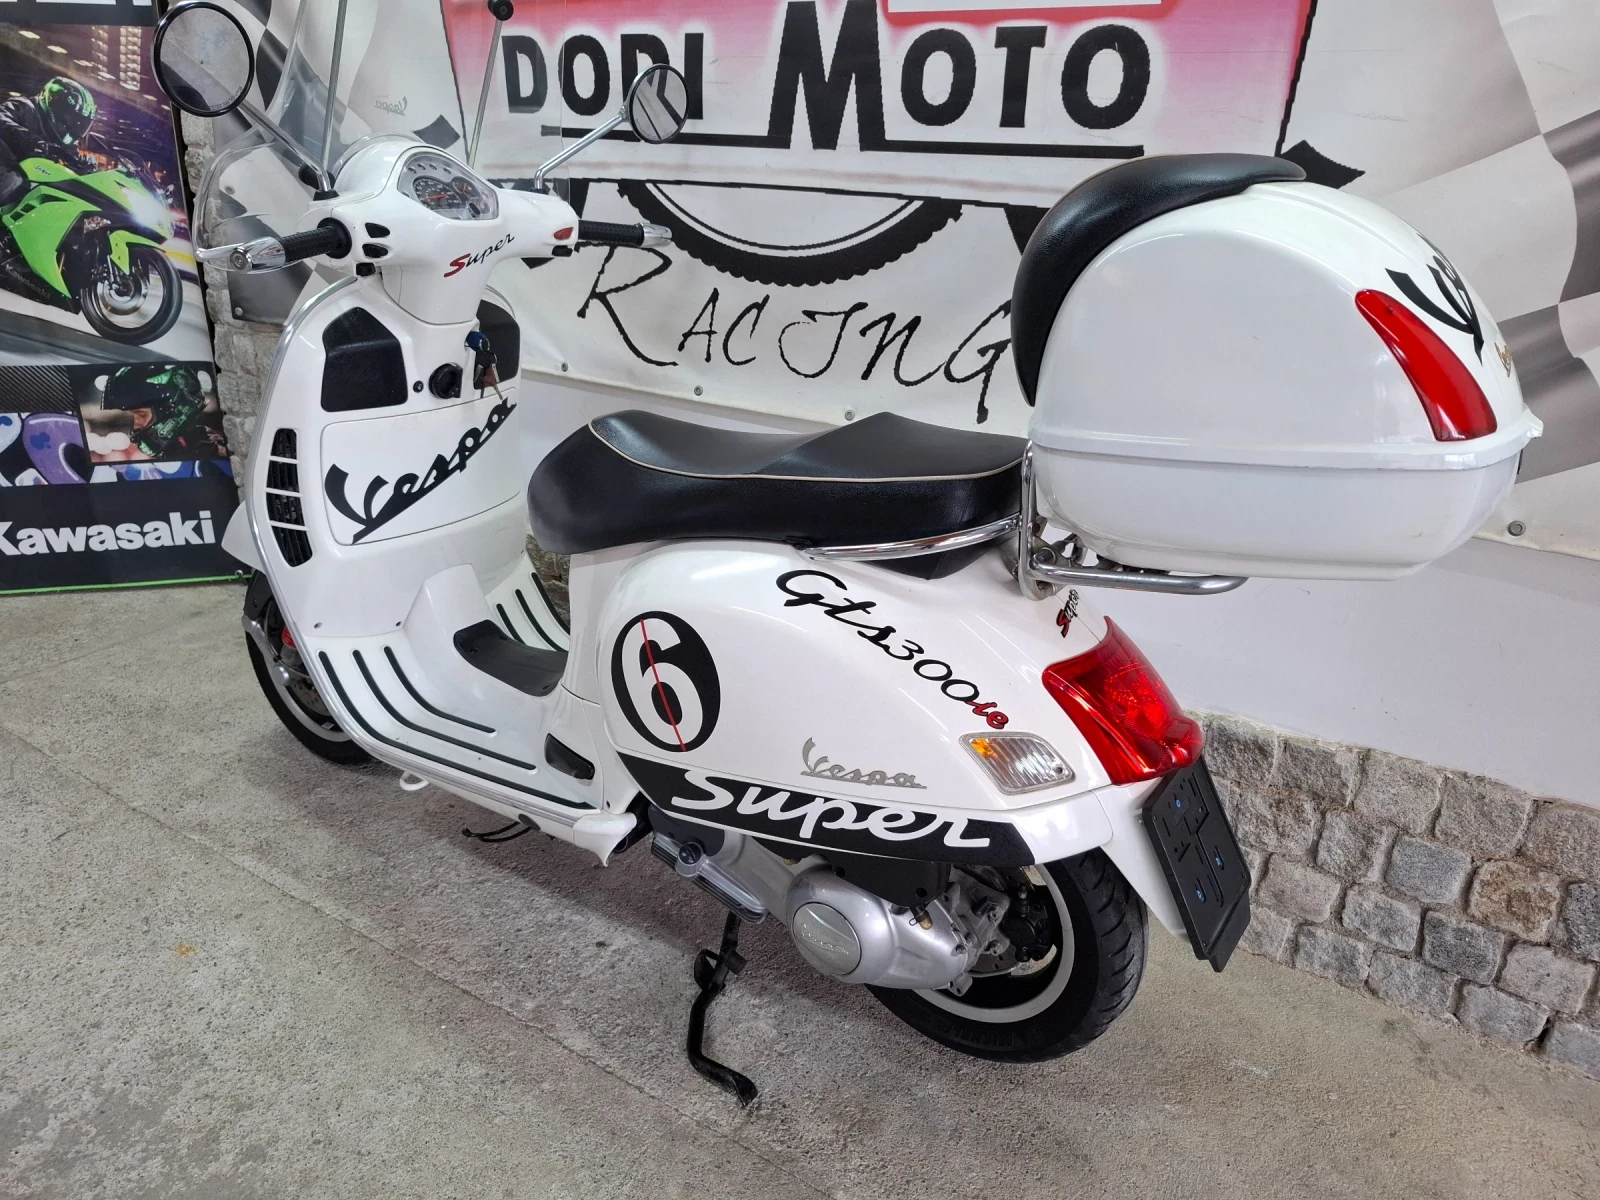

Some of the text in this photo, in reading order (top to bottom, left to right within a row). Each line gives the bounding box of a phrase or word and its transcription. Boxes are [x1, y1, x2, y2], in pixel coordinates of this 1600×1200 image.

[768, 0, 1151, 151] MOTO
[443, 233, 515, 278] Super
[576, 244, 1013, 425] RACING
[324, 397, 518, 545] Vespa
[621, 617, 704, 746] 6
[671, 770, 991, 848] Super
[801, 736, 928, 790] Vespa
